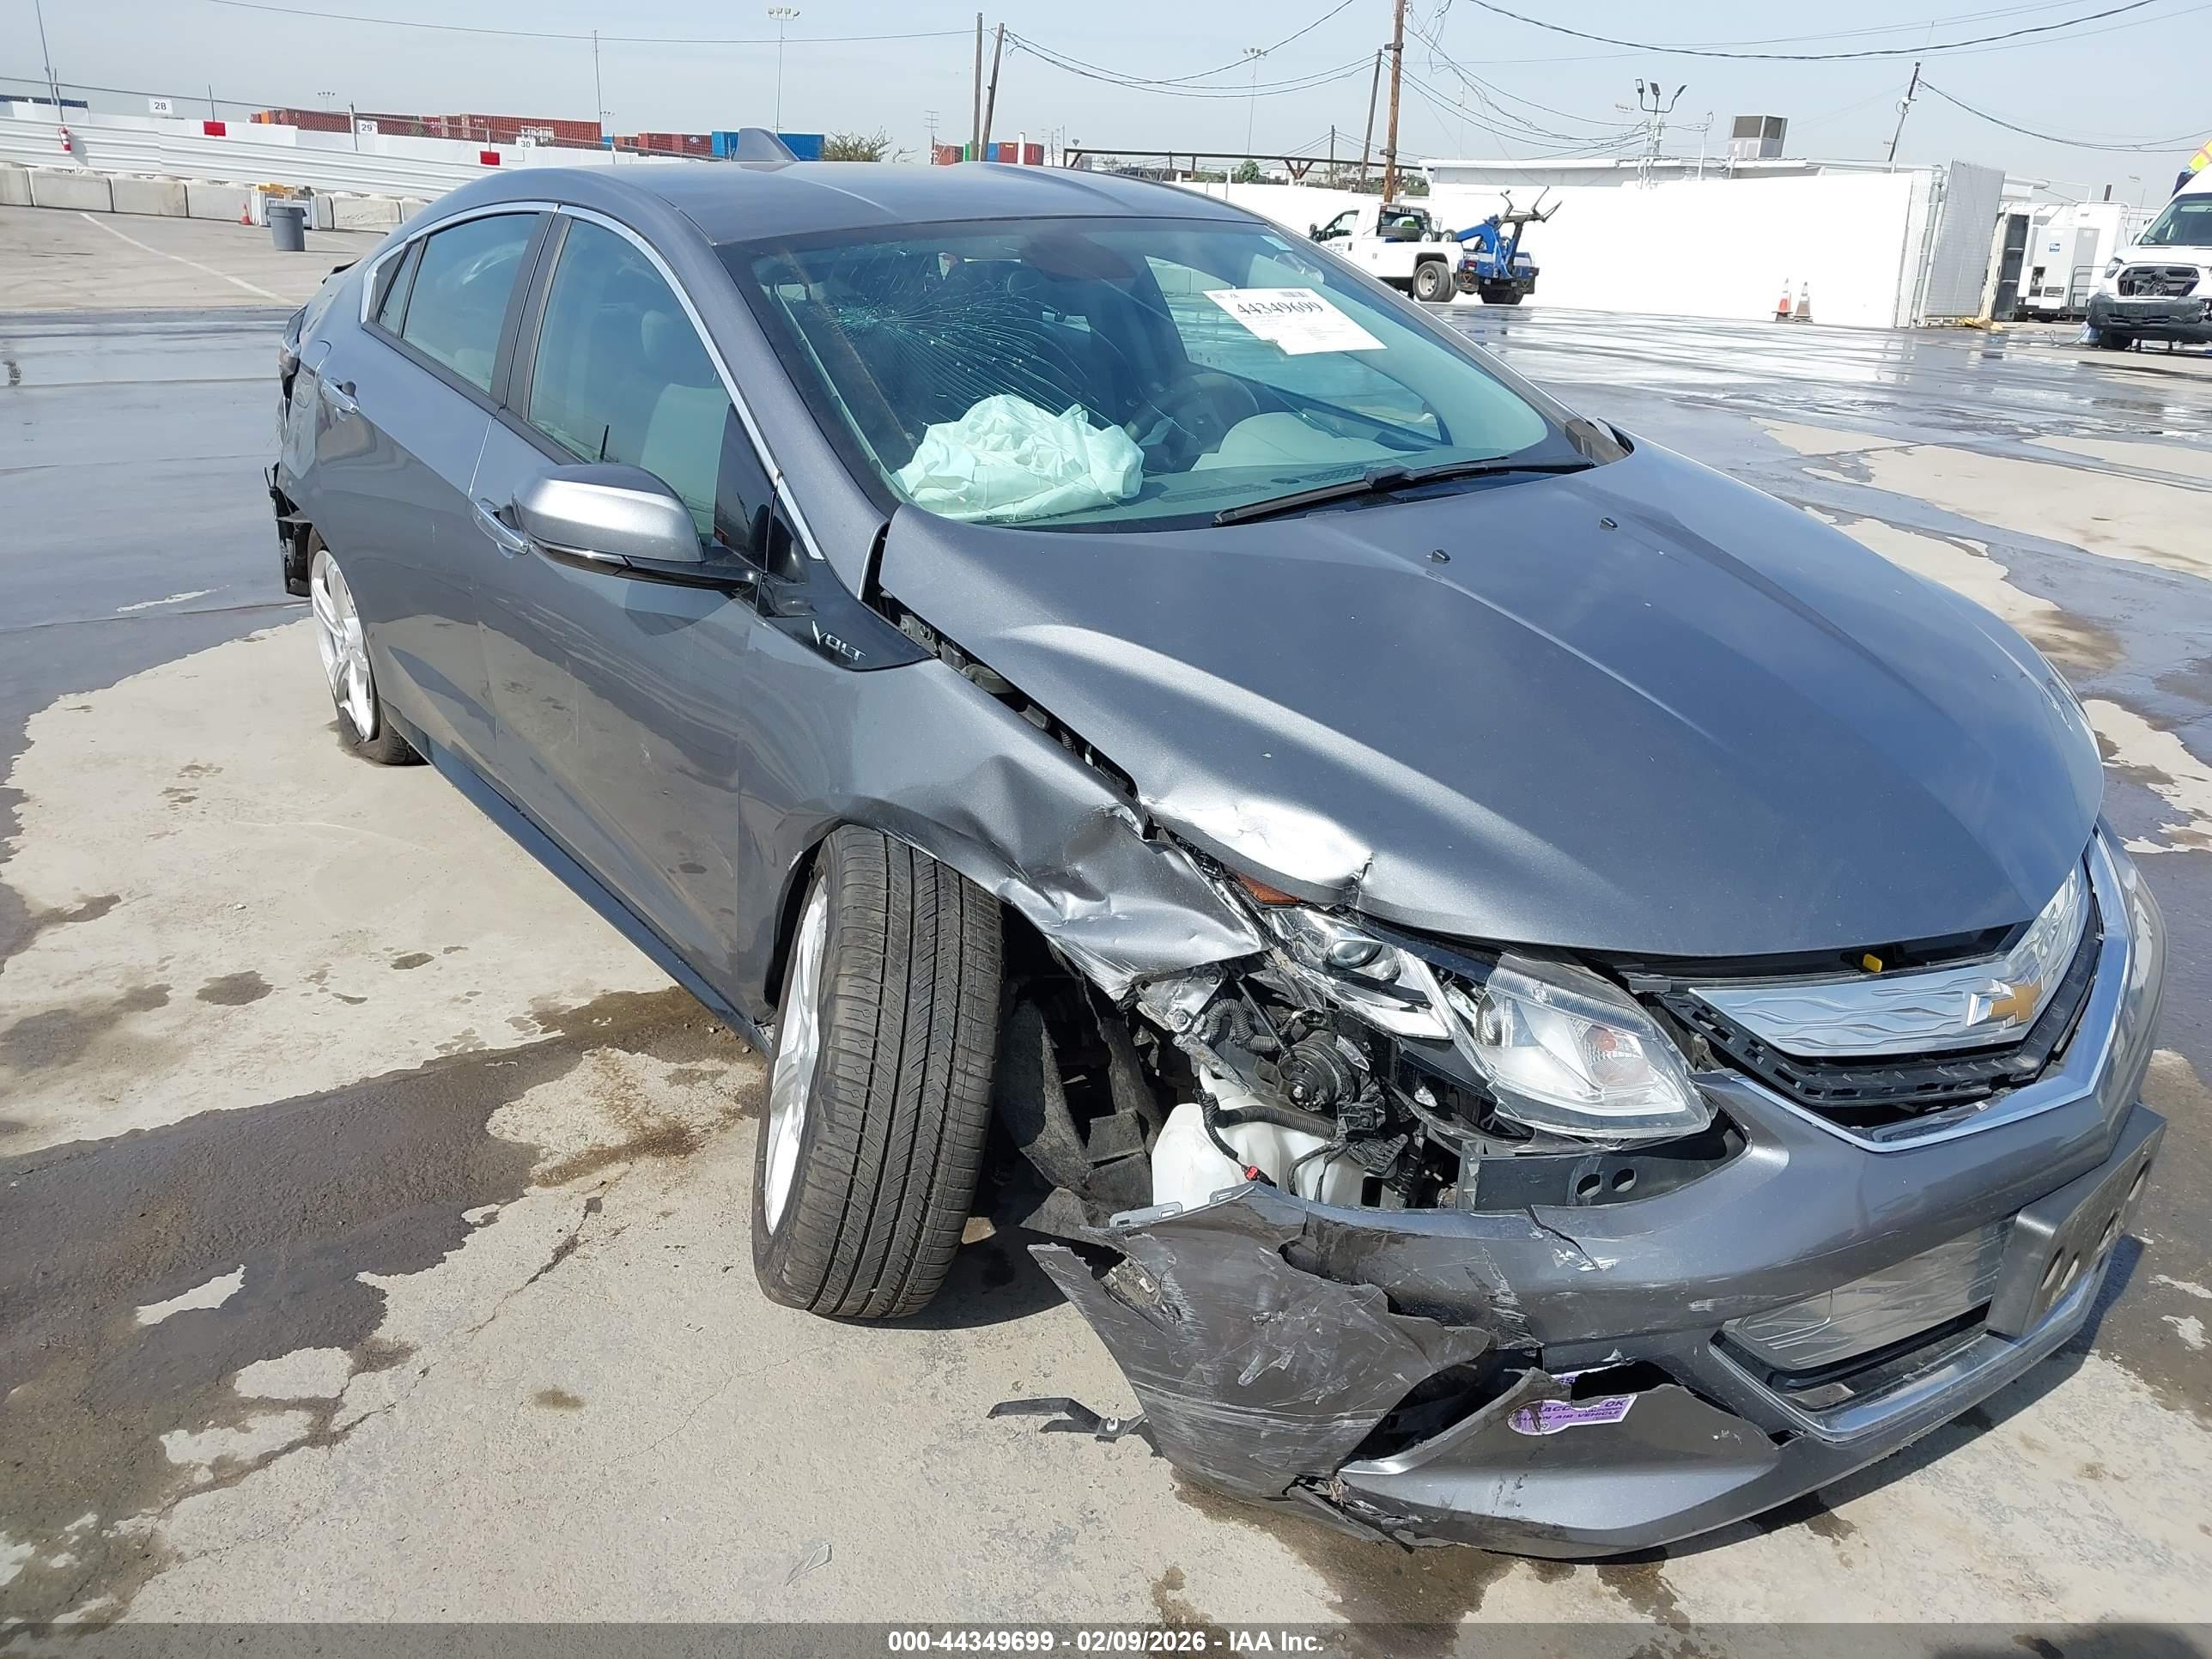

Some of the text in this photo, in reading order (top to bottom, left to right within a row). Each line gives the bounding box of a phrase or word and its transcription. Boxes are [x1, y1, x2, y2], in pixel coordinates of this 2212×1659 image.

[154, 101, 167, 111] 28
[361, 123, 373, 132] 29
[520, 140, 531, 149] 30
[1237, 301, 1324, 316] 44349699
[811, 620, 866, 662] VOLT
